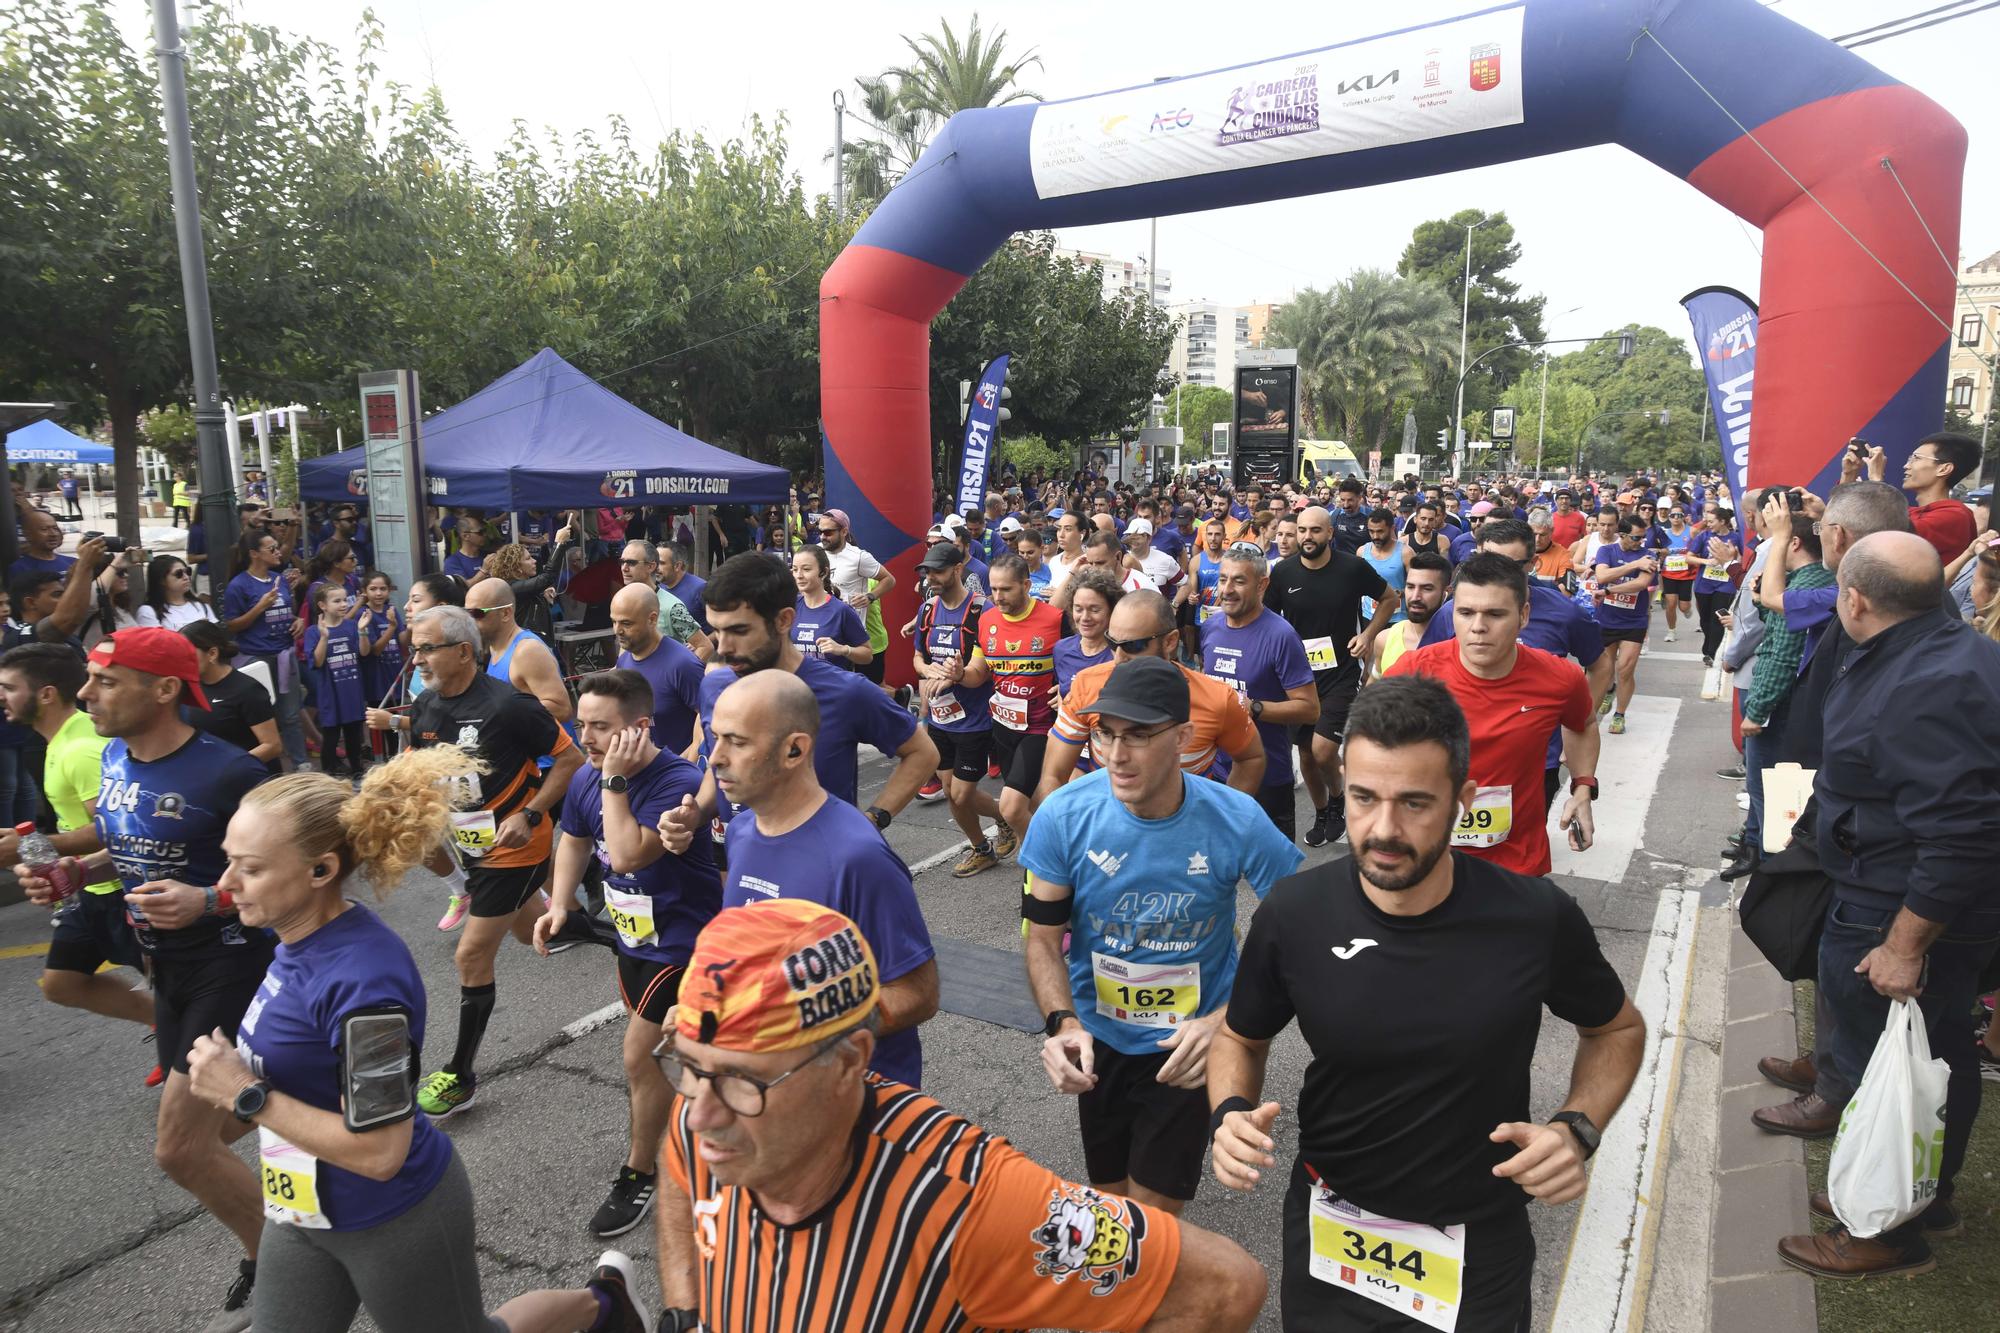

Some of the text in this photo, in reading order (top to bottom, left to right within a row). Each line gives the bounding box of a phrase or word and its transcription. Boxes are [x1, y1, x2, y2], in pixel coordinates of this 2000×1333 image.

[1295, 64, 1318, 76] 2022
[1256, 74, 1317, 98] CARRERA
[1337, 69, 1400, 95] KIA
[1275, 87, 1318, 109] DE LAS
[1412, 89, 1453, 102] Ayuntamiento
[1418, 99, 1448, 109] de Murcia
[1150, 108, 1194, 133] AEG
[1252, 102, 1320, 128] CIUDADES
[1222, 133, 1245, 143] CONTRA
[1245, 131, 1253, 140] EL
[1277, 125, 1286, 134] DE
[1718, 310, 1754, 339] DORSAL
[1726, 329, 1757, 359] 21
[983, 390, 996, 411] 21
[958, 419, 991, 518] ORSAL21
[614, 477, 729, 498] 21 DORSAL21.COM
[1613, 593, 1631, 602] 103
[995, 705, 1017, 721] 003
[95, 777, 141, 813] 764
[1111, 892, 1197, 923] 42K
[612, 908, 637, 933] 291
[1104, 935, 1119, 950] WE
[1138, 939, 1198, 952] MARATHON
[799, 963, 873, 1030] BIRRAS
[1117, 986, 1175, 1007] 162
[1342, 1230, 1427, 1282] 344
[1367, 1275, 1400, 1293] KIA
